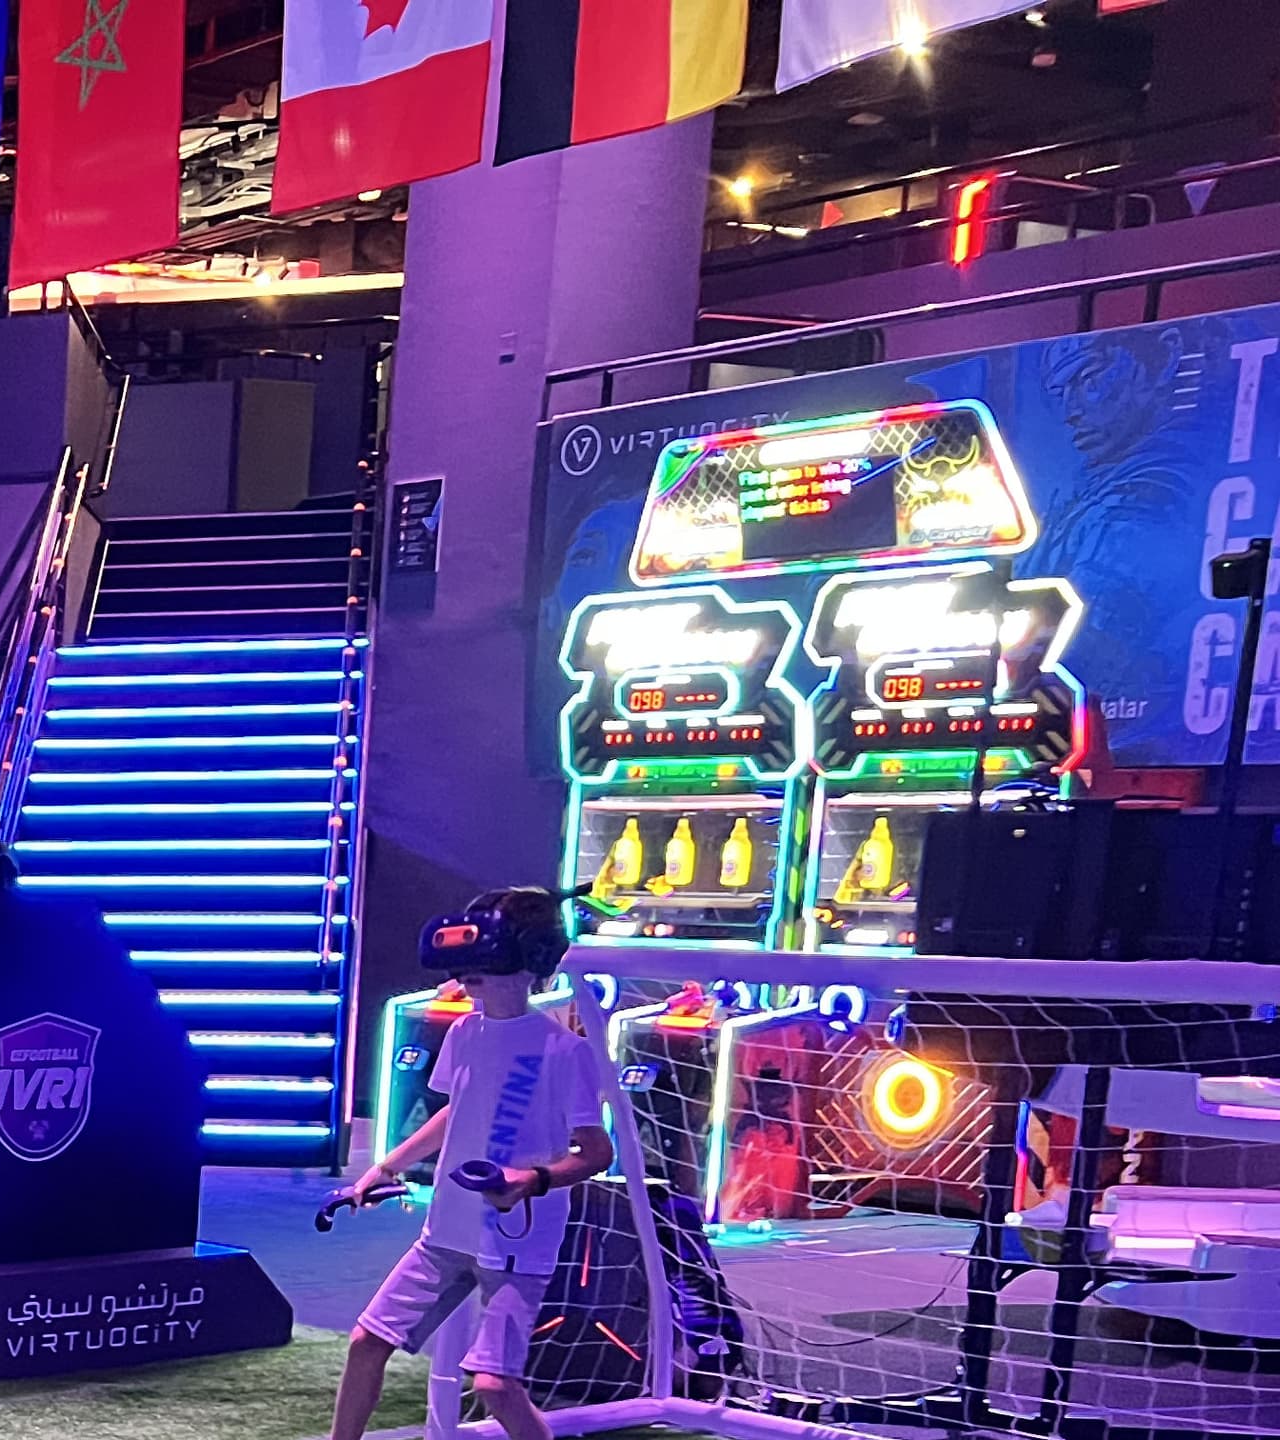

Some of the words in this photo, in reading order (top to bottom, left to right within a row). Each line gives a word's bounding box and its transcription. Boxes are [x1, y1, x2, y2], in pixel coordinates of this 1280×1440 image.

[883, 676, 923, 699] 098
[629, 690, 664, 711] 098
[1100, 696, 1148, 720] atar
